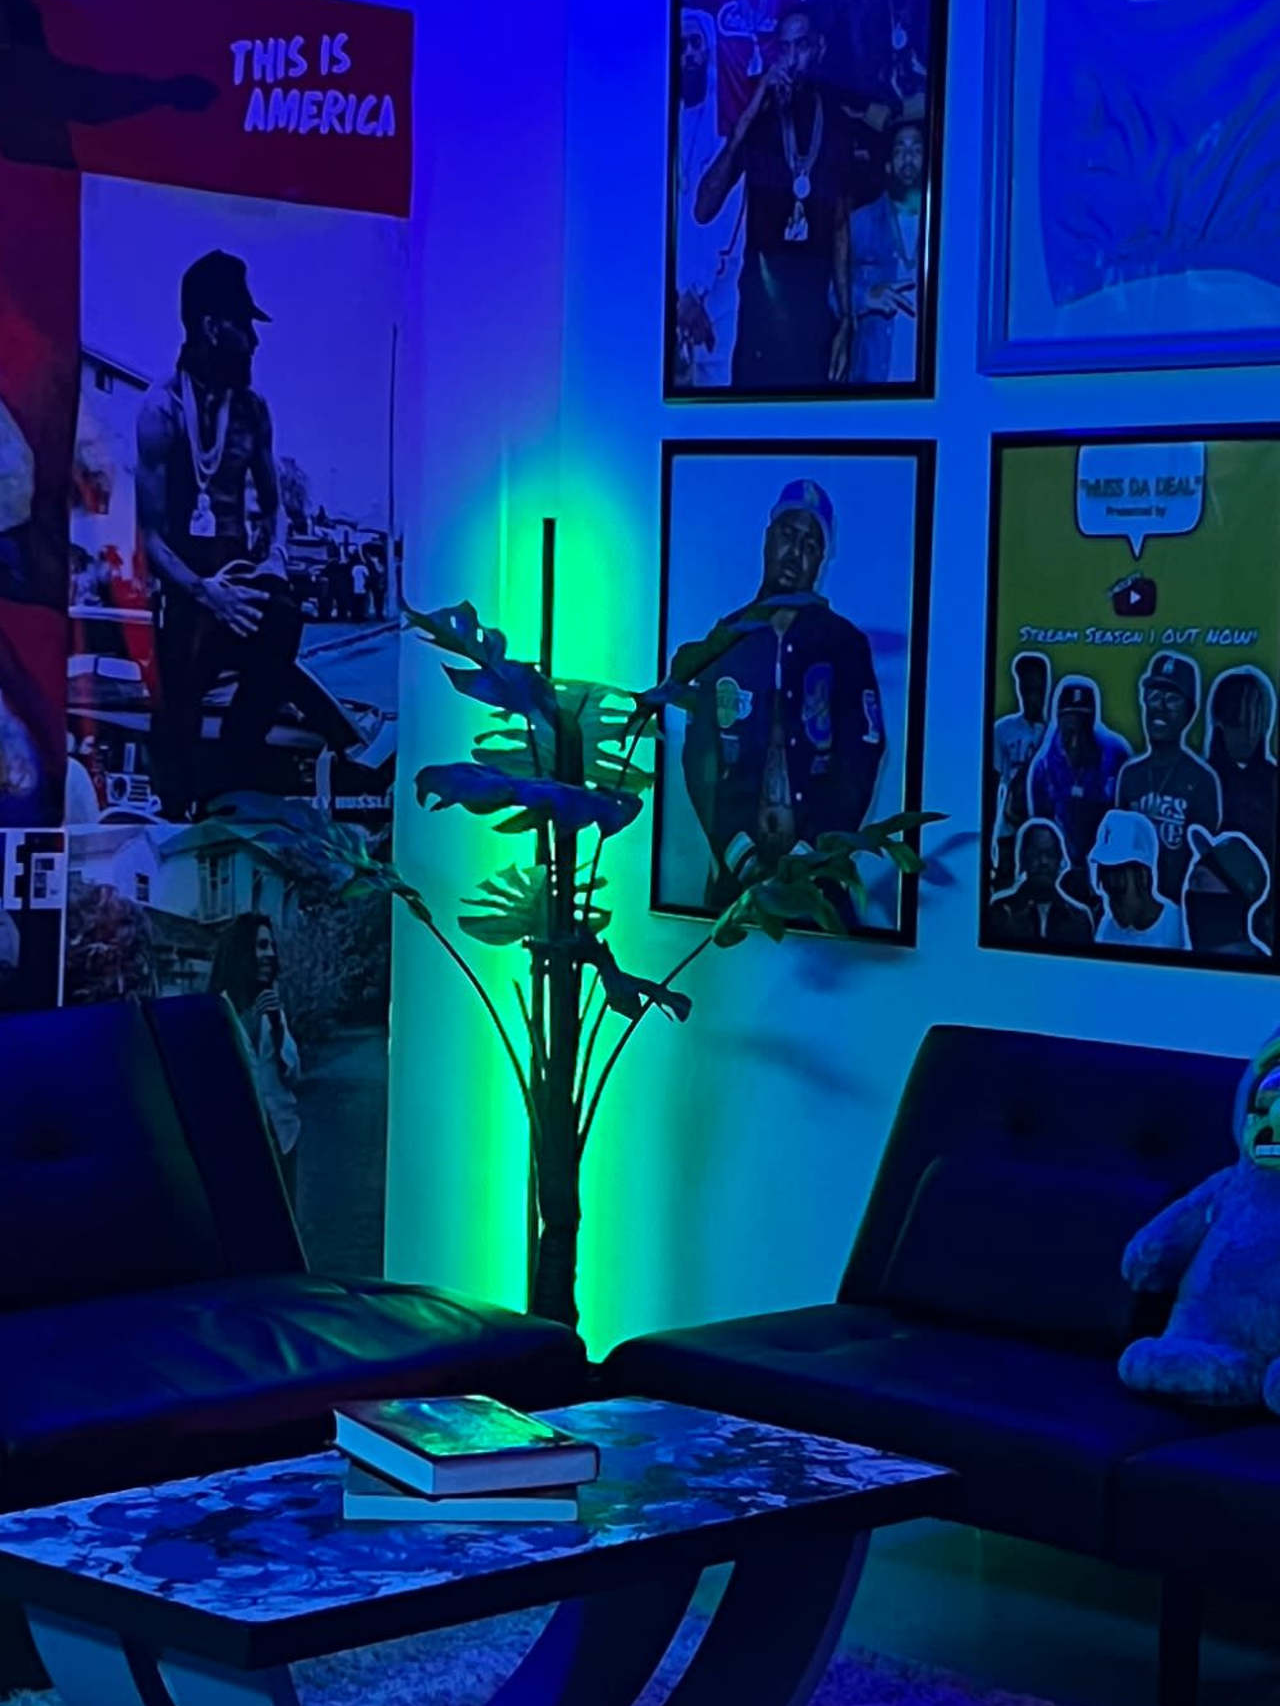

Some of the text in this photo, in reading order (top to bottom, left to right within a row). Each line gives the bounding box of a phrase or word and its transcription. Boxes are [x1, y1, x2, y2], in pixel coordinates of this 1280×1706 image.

[229, 31, 352, 86] THIS IS
[243, 86, 397, 138] AMERICA
[1161, 626, 1202, 644] OUT
